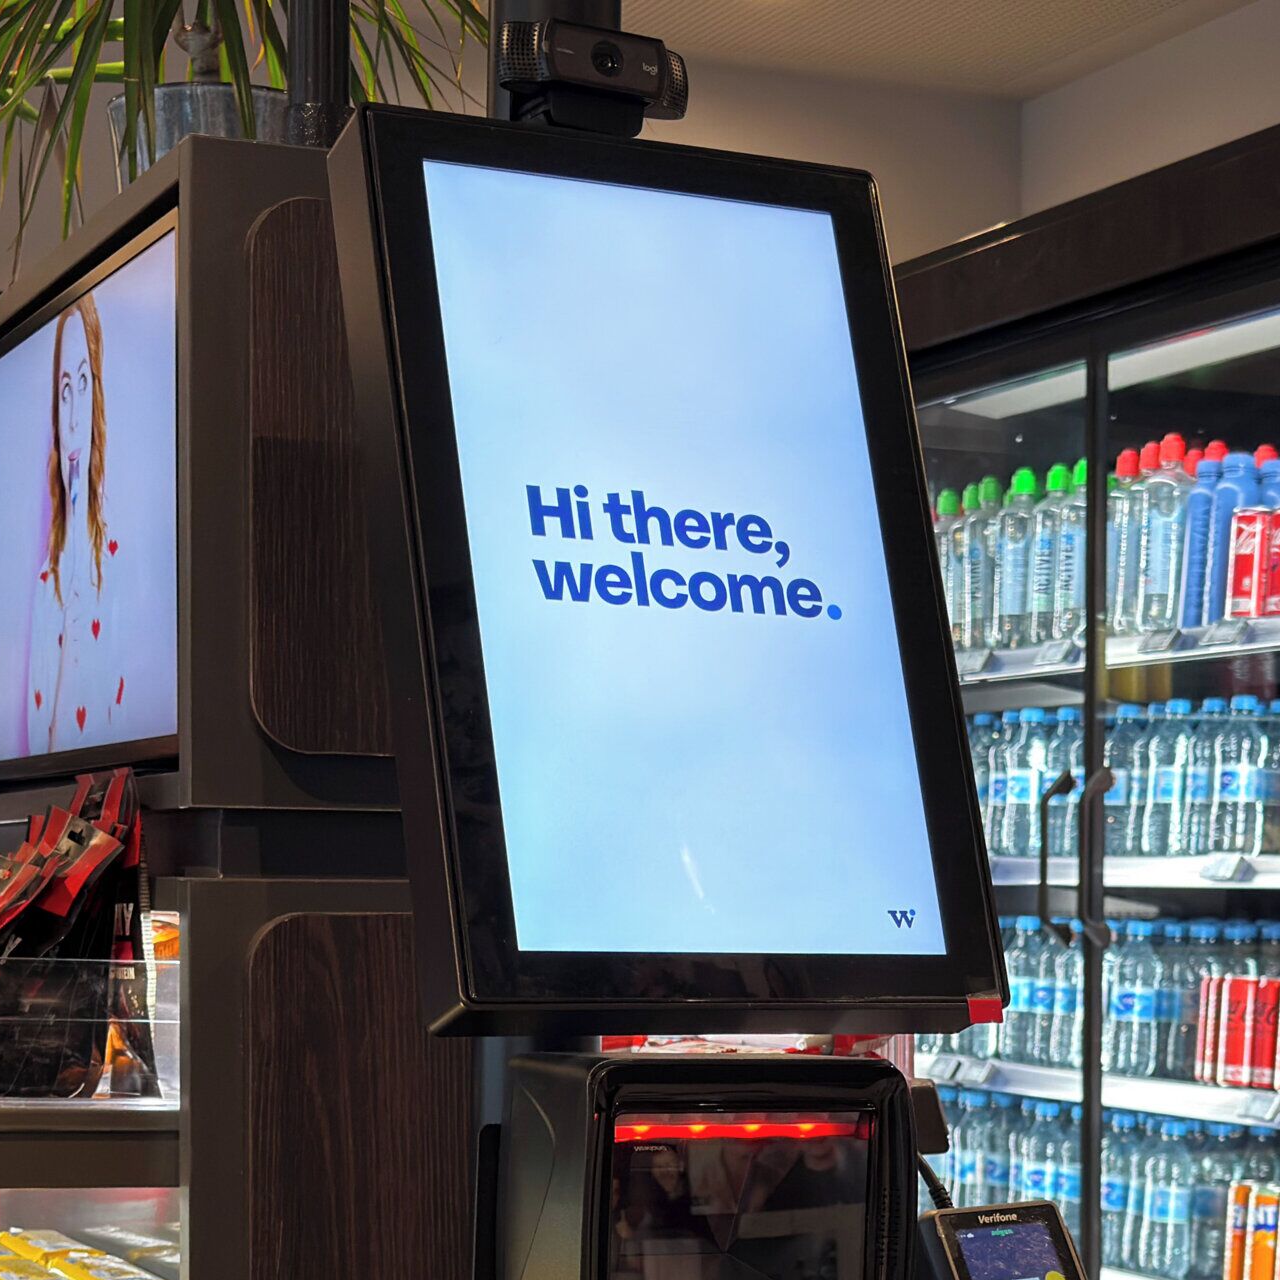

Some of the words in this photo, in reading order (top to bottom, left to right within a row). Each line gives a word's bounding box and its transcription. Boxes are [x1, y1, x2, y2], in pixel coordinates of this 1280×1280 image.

[526, 484, 593, 540] Hi
[602, 490, 791, 568] there,
[531, 554, 843, 621] welcome.
[978, 1212, 1018, 1226] Verifone
